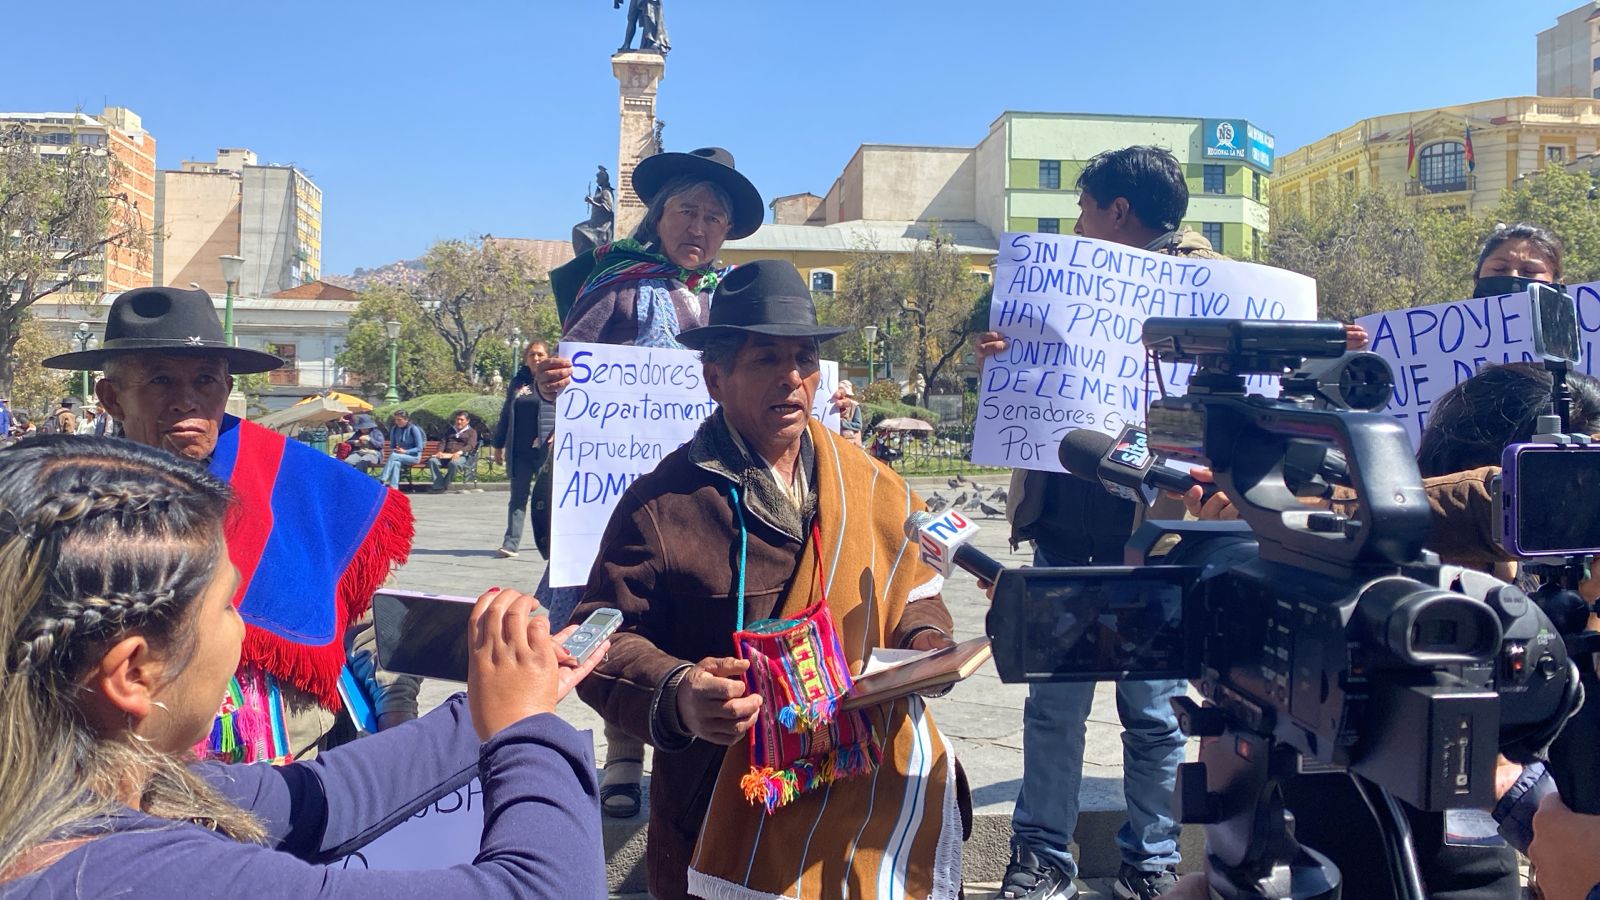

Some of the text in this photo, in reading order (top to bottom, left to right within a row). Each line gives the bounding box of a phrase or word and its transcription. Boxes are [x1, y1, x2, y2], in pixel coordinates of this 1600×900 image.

[1237, 149, 1245, 157] PAZ
[1011, 235, 1212, 288] SIN CONTRATO
[1007, 266, 1287, 320] ADMINISTRATIVO NO
[998, 301, 1143, 345] HAY PROD
[1371, 295, 1522, 358] APOYE
[571, 351, 700, 390] Senadores
[994, 337, 1106, 378] CONTINUA
[1035, 371, 1179, 412] CEMENT
[1387, 364, 1431, 410] UE
[564, 388, 721, 428] Departament
[983, 396, 1096, 427] Senadores
[556, 431, 663, 467] Aprueben
[998, 426, 1046, 462] Por
[559, 470, 643, 508] ADM
[926, 511, 967, 541] TVU
